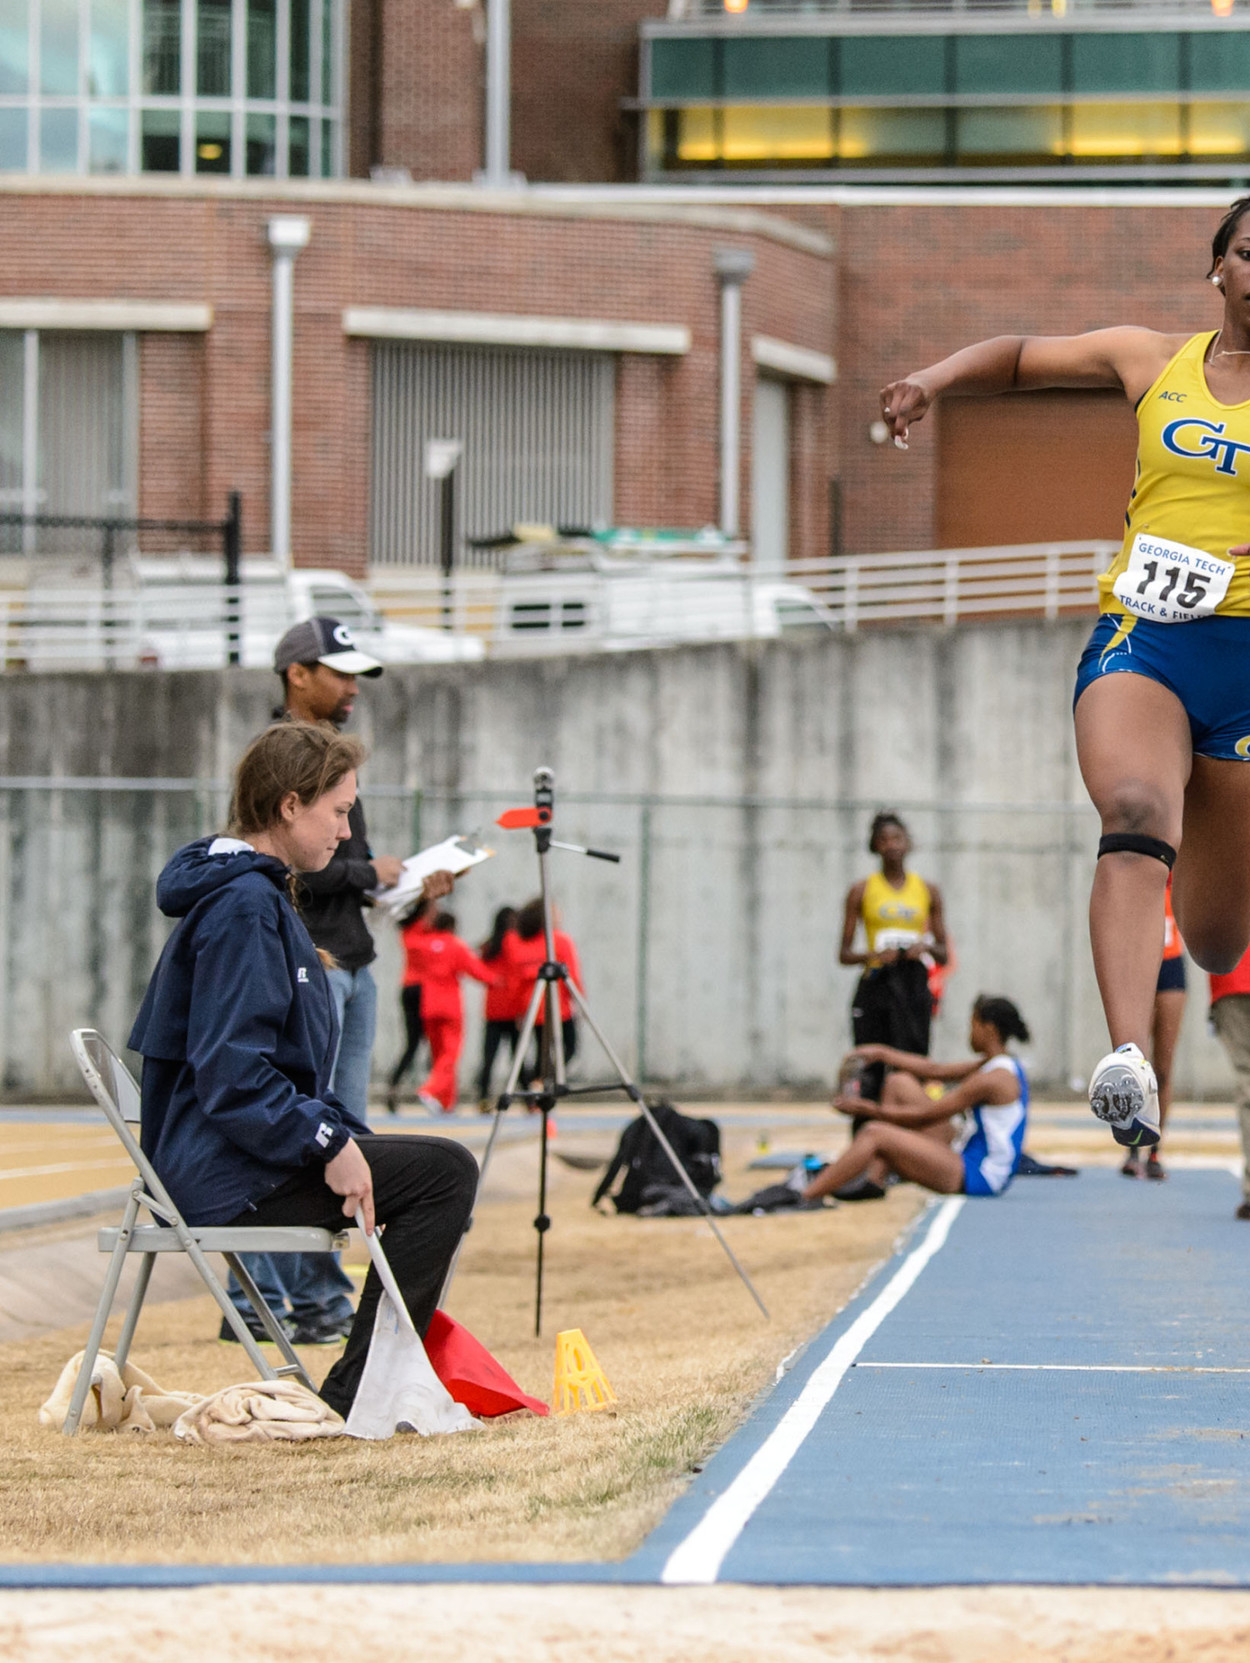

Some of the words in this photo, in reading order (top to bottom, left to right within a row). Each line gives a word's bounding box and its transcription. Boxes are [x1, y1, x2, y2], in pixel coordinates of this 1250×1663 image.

[1159, 391, 1187, 403] ACC
[1139, 543, 1190, 565] GEORGIA
[1195, 558, 1226, 576] TECH
[1136, 560, 1211, 609] 115
[1120, 594, 1156, 614] TRACK
[1160, 607, 1167, 617] &
